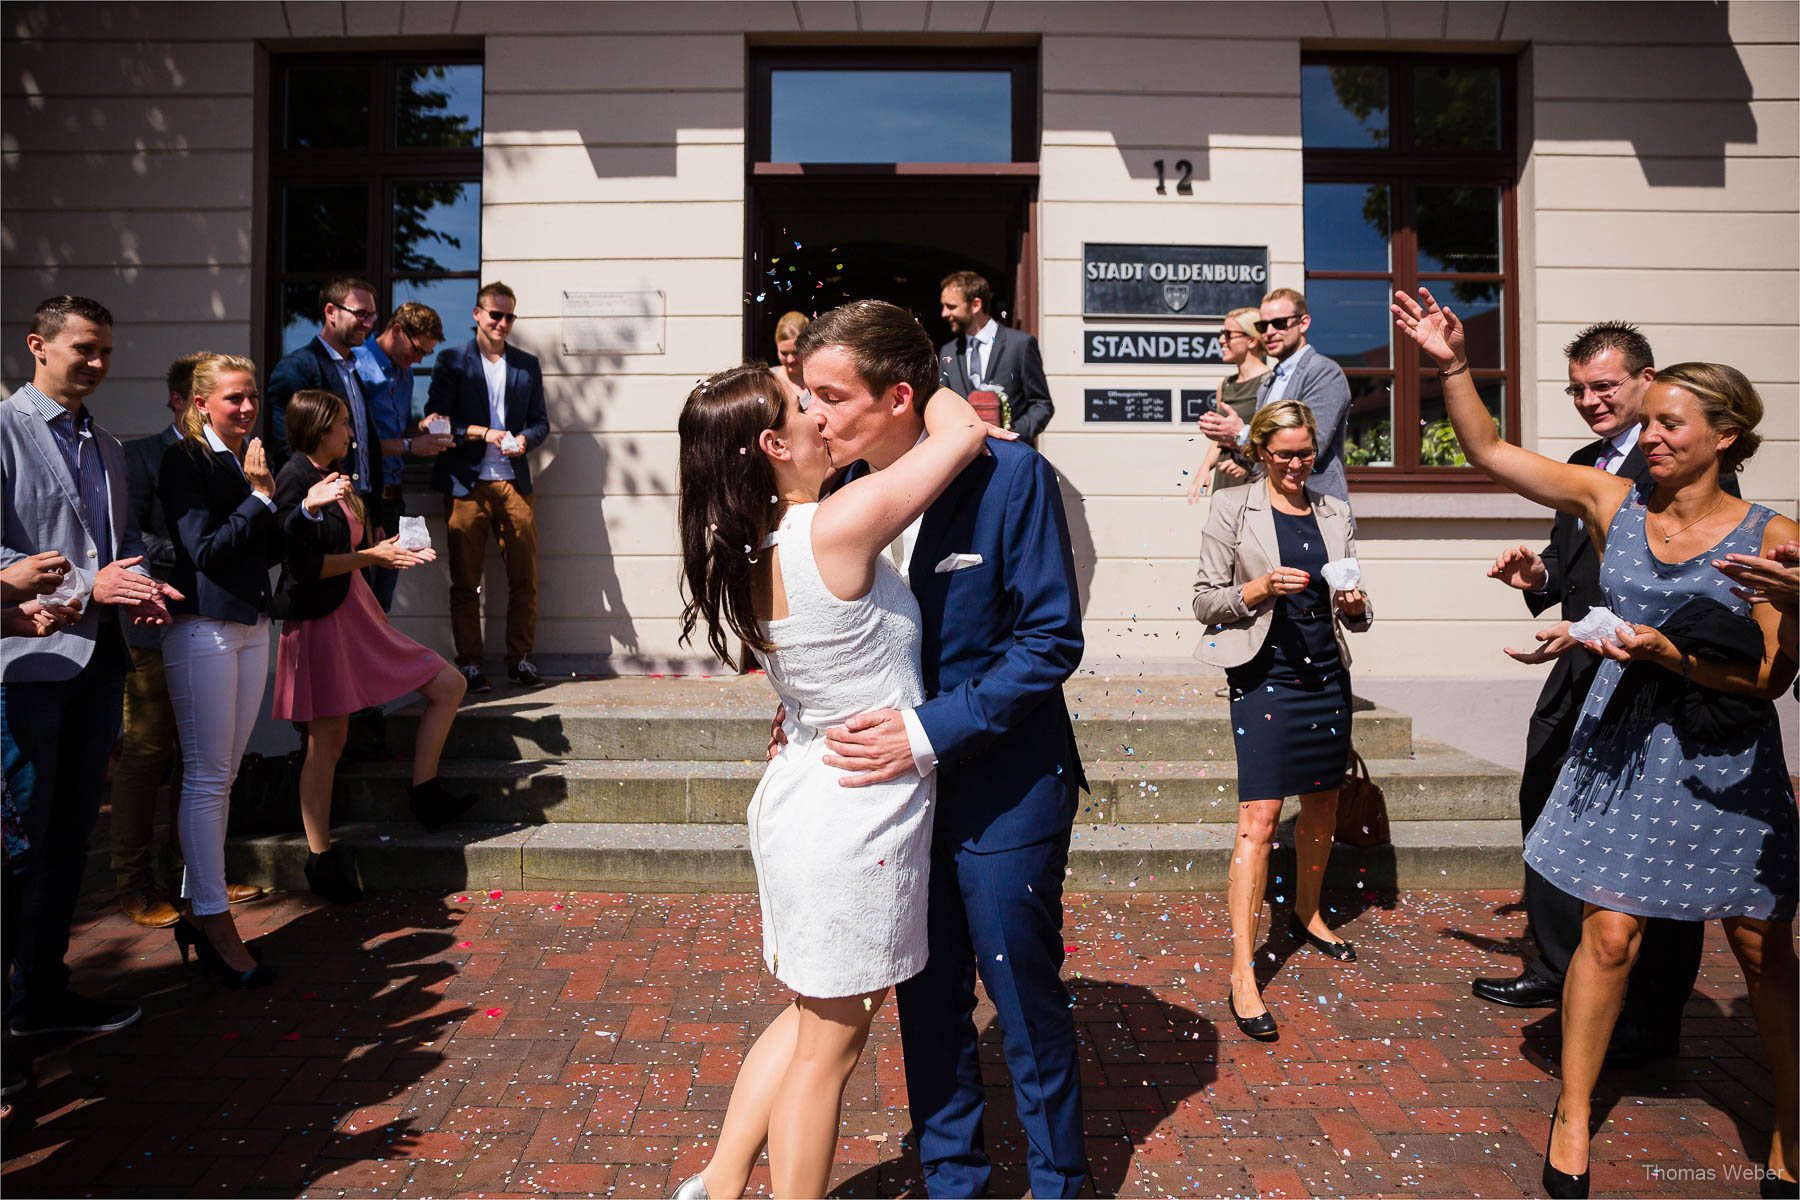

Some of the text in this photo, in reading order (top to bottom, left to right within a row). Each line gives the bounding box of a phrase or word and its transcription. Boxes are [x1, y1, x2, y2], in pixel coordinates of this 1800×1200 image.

[1153, 159, 1193, 195] 12
[1086, 261, 1266, 283] STADT OLDENBURG
[1091, 335, 1224, 358] STANDESA
